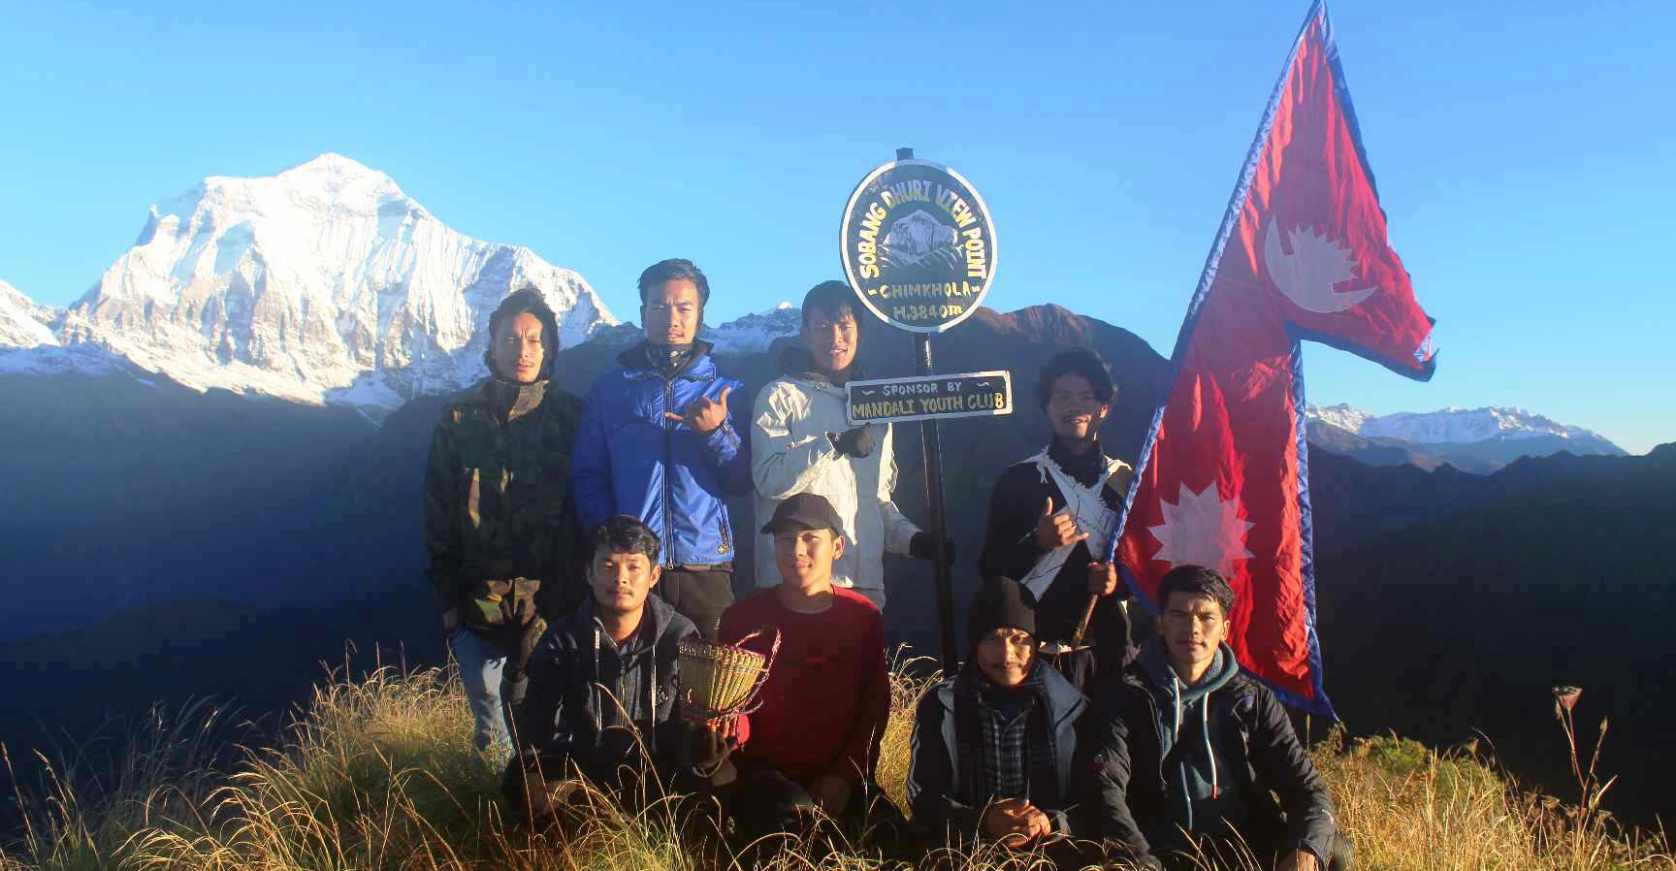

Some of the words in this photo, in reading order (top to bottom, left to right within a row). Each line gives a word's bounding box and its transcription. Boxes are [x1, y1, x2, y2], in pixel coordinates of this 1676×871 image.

[858, 202, 887, 279] SOBANG
[880, 180, 932, 209] DHURI
[935, 184, 977, 228] VIEW
[962, 227, 987, 279] POINT
[879, 281, 972, 299] CHIMKHOLA
[882, 383, 938, 396] SPONSOR
[947, 382, 962, 392] BY
[852, 399, 915, 417] MANDALI
[920, 396, 963, 412] YOUTH
[968, 393, 1004, 409] CLUB
